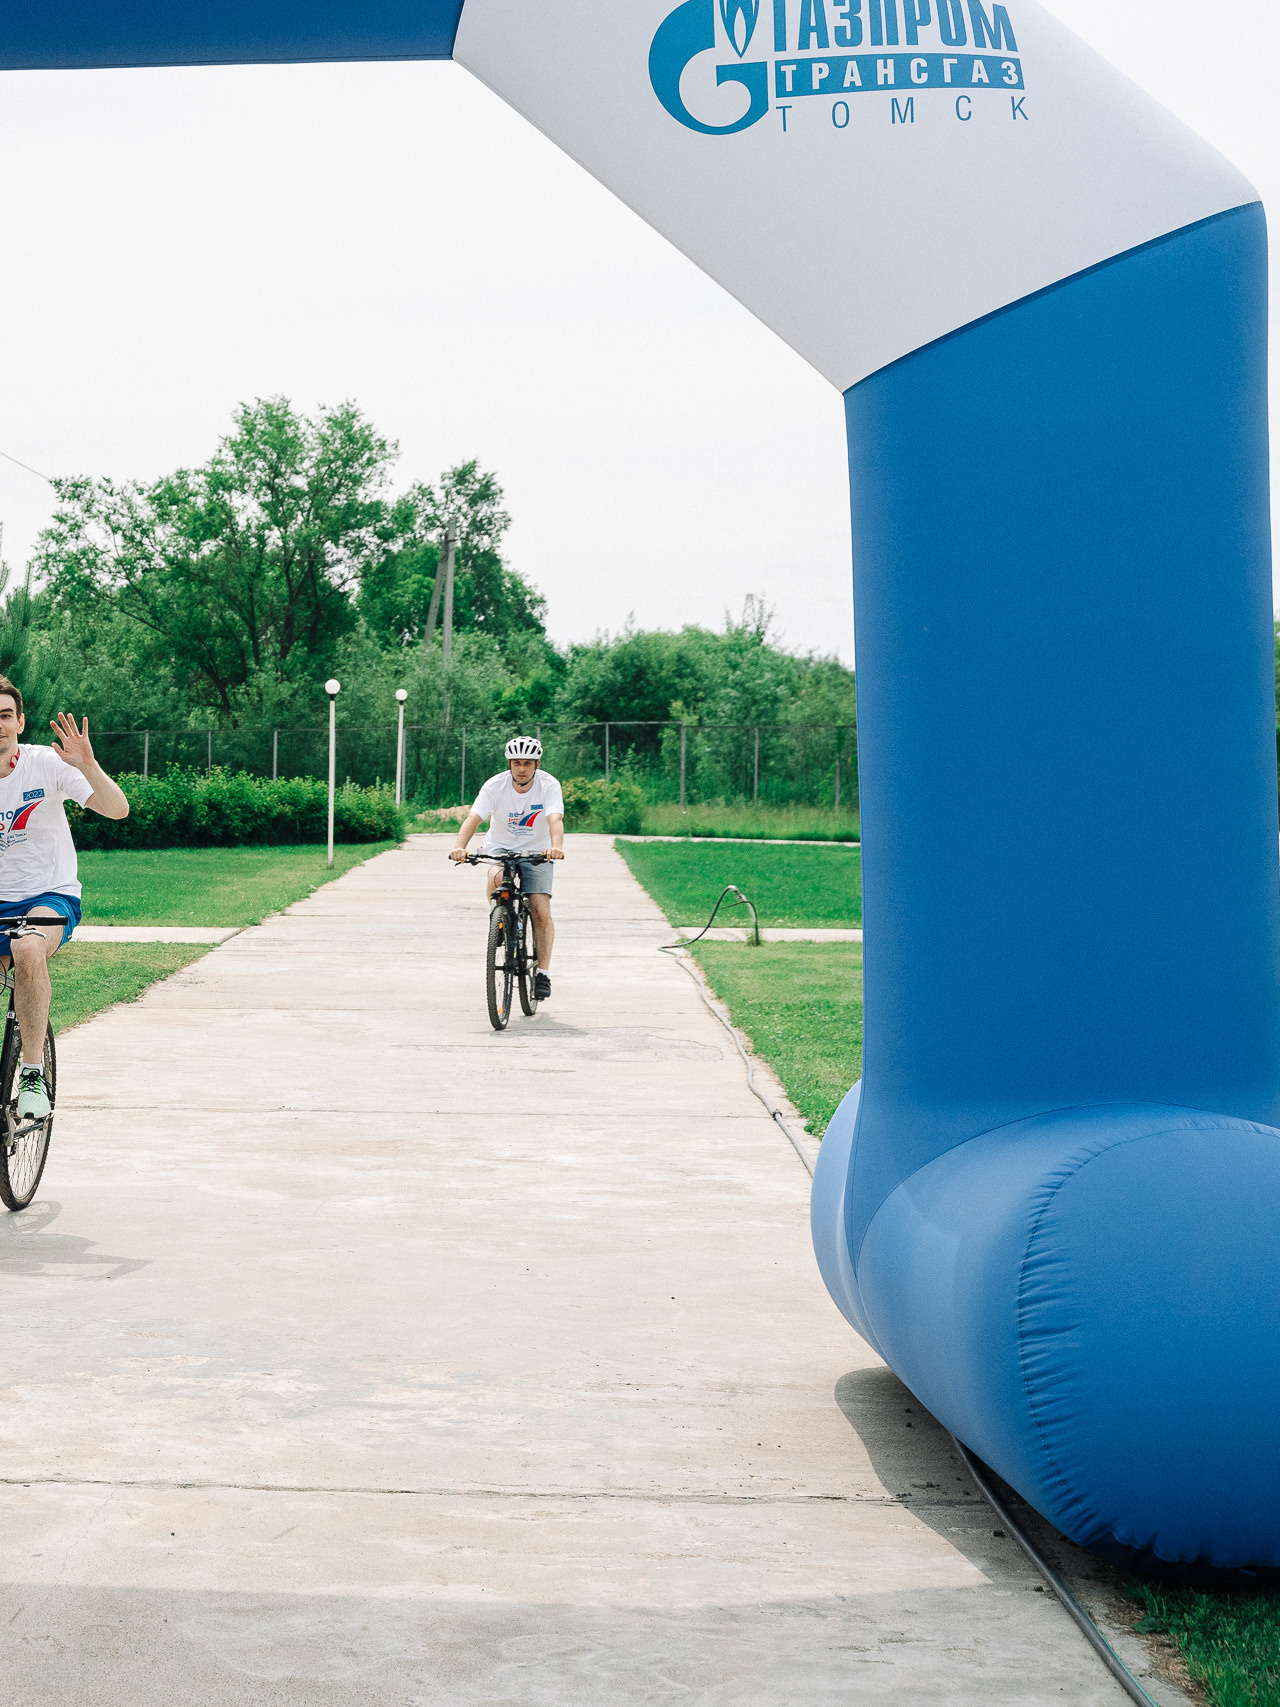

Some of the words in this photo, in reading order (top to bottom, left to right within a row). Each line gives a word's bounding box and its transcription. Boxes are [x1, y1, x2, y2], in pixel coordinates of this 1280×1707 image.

[773, 0, 1019, 52] ГАЗПРОМ
[780, 58, 1019, 92] ТРАНСГАЗ
[776, 94, 1029, 132] ТОМСК
[24, 789, 44, 800] 2022
